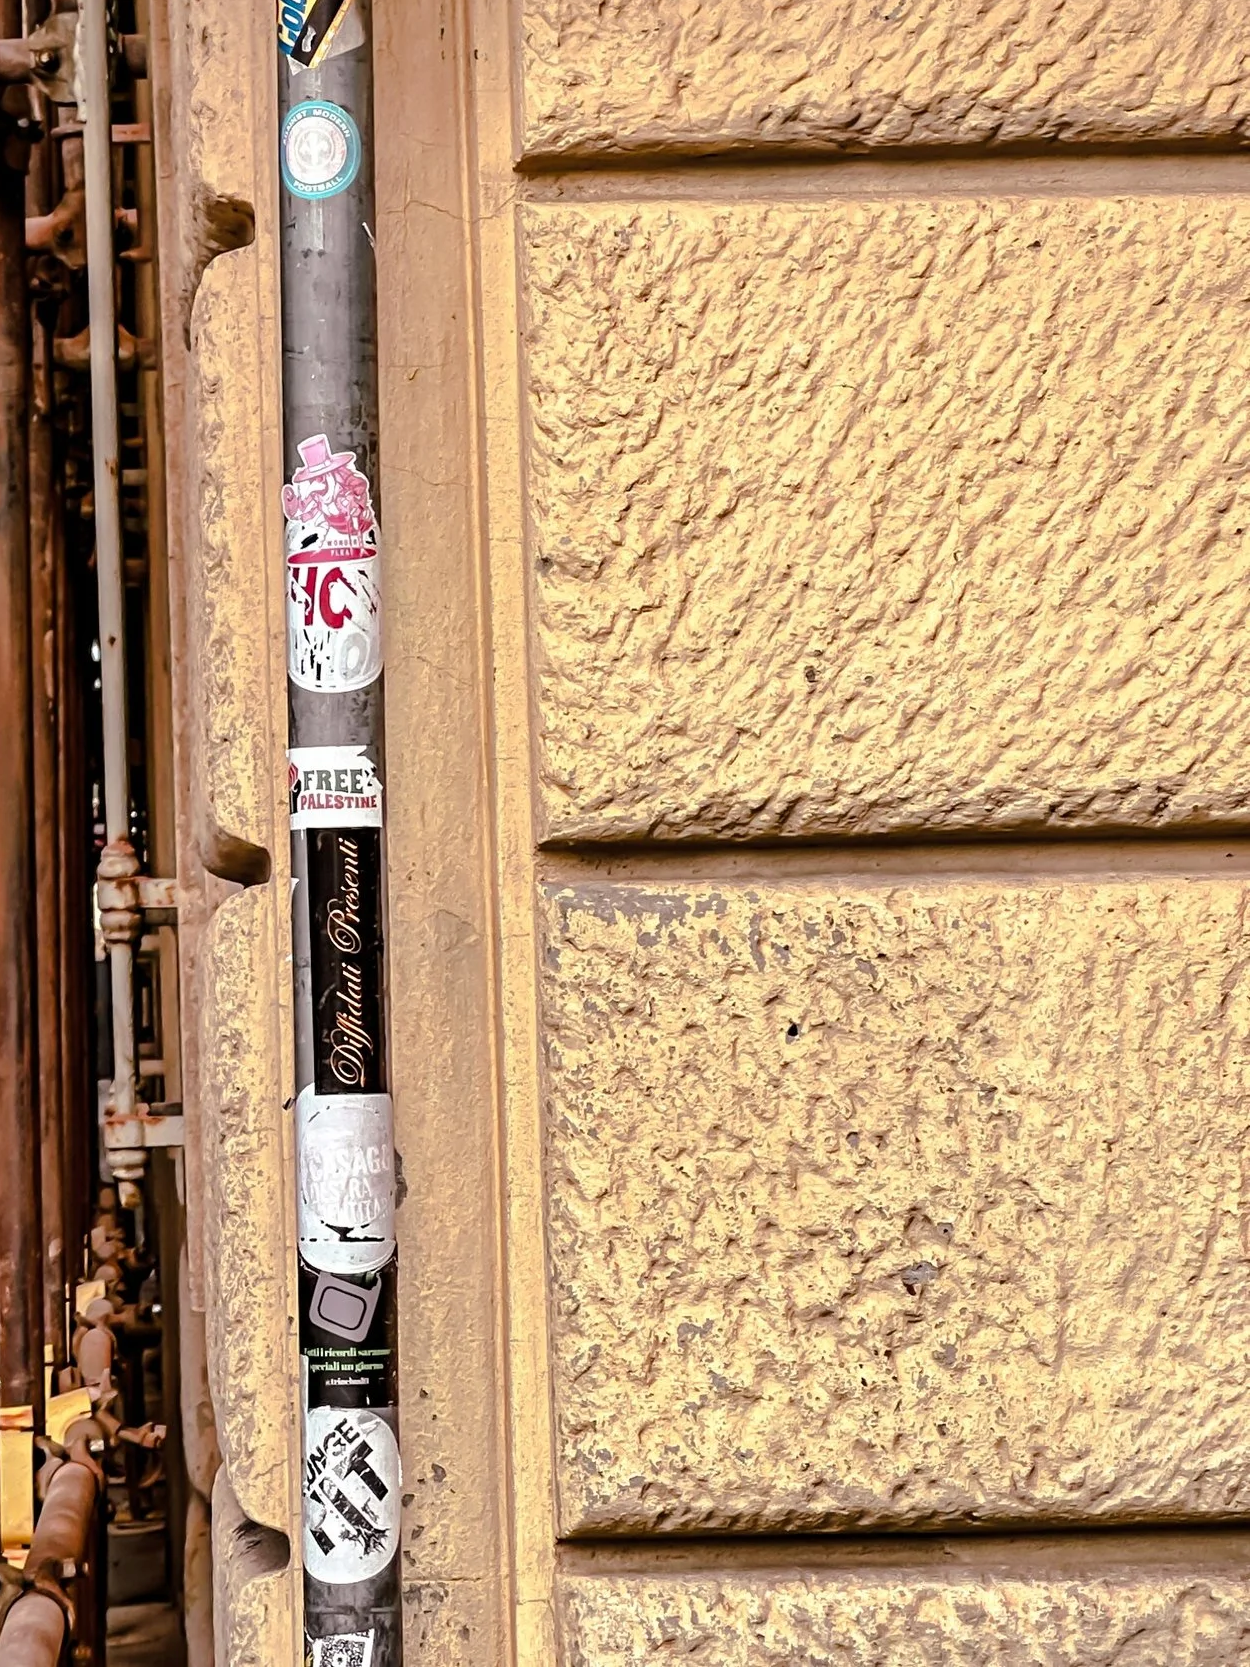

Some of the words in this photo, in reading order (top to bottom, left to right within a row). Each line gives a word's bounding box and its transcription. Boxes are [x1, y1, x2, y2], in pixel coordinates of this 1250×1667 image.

[312, 108, 351, 138] MODERN
[293, 175, 343, 193] FOOTBALL
[302, 768, 364, 794] FREE
[300, 793, 378, 811] PALESTINE
[326, 837, 362, 954] Presenti
[330, 961, 374, 1088] Diffidati
